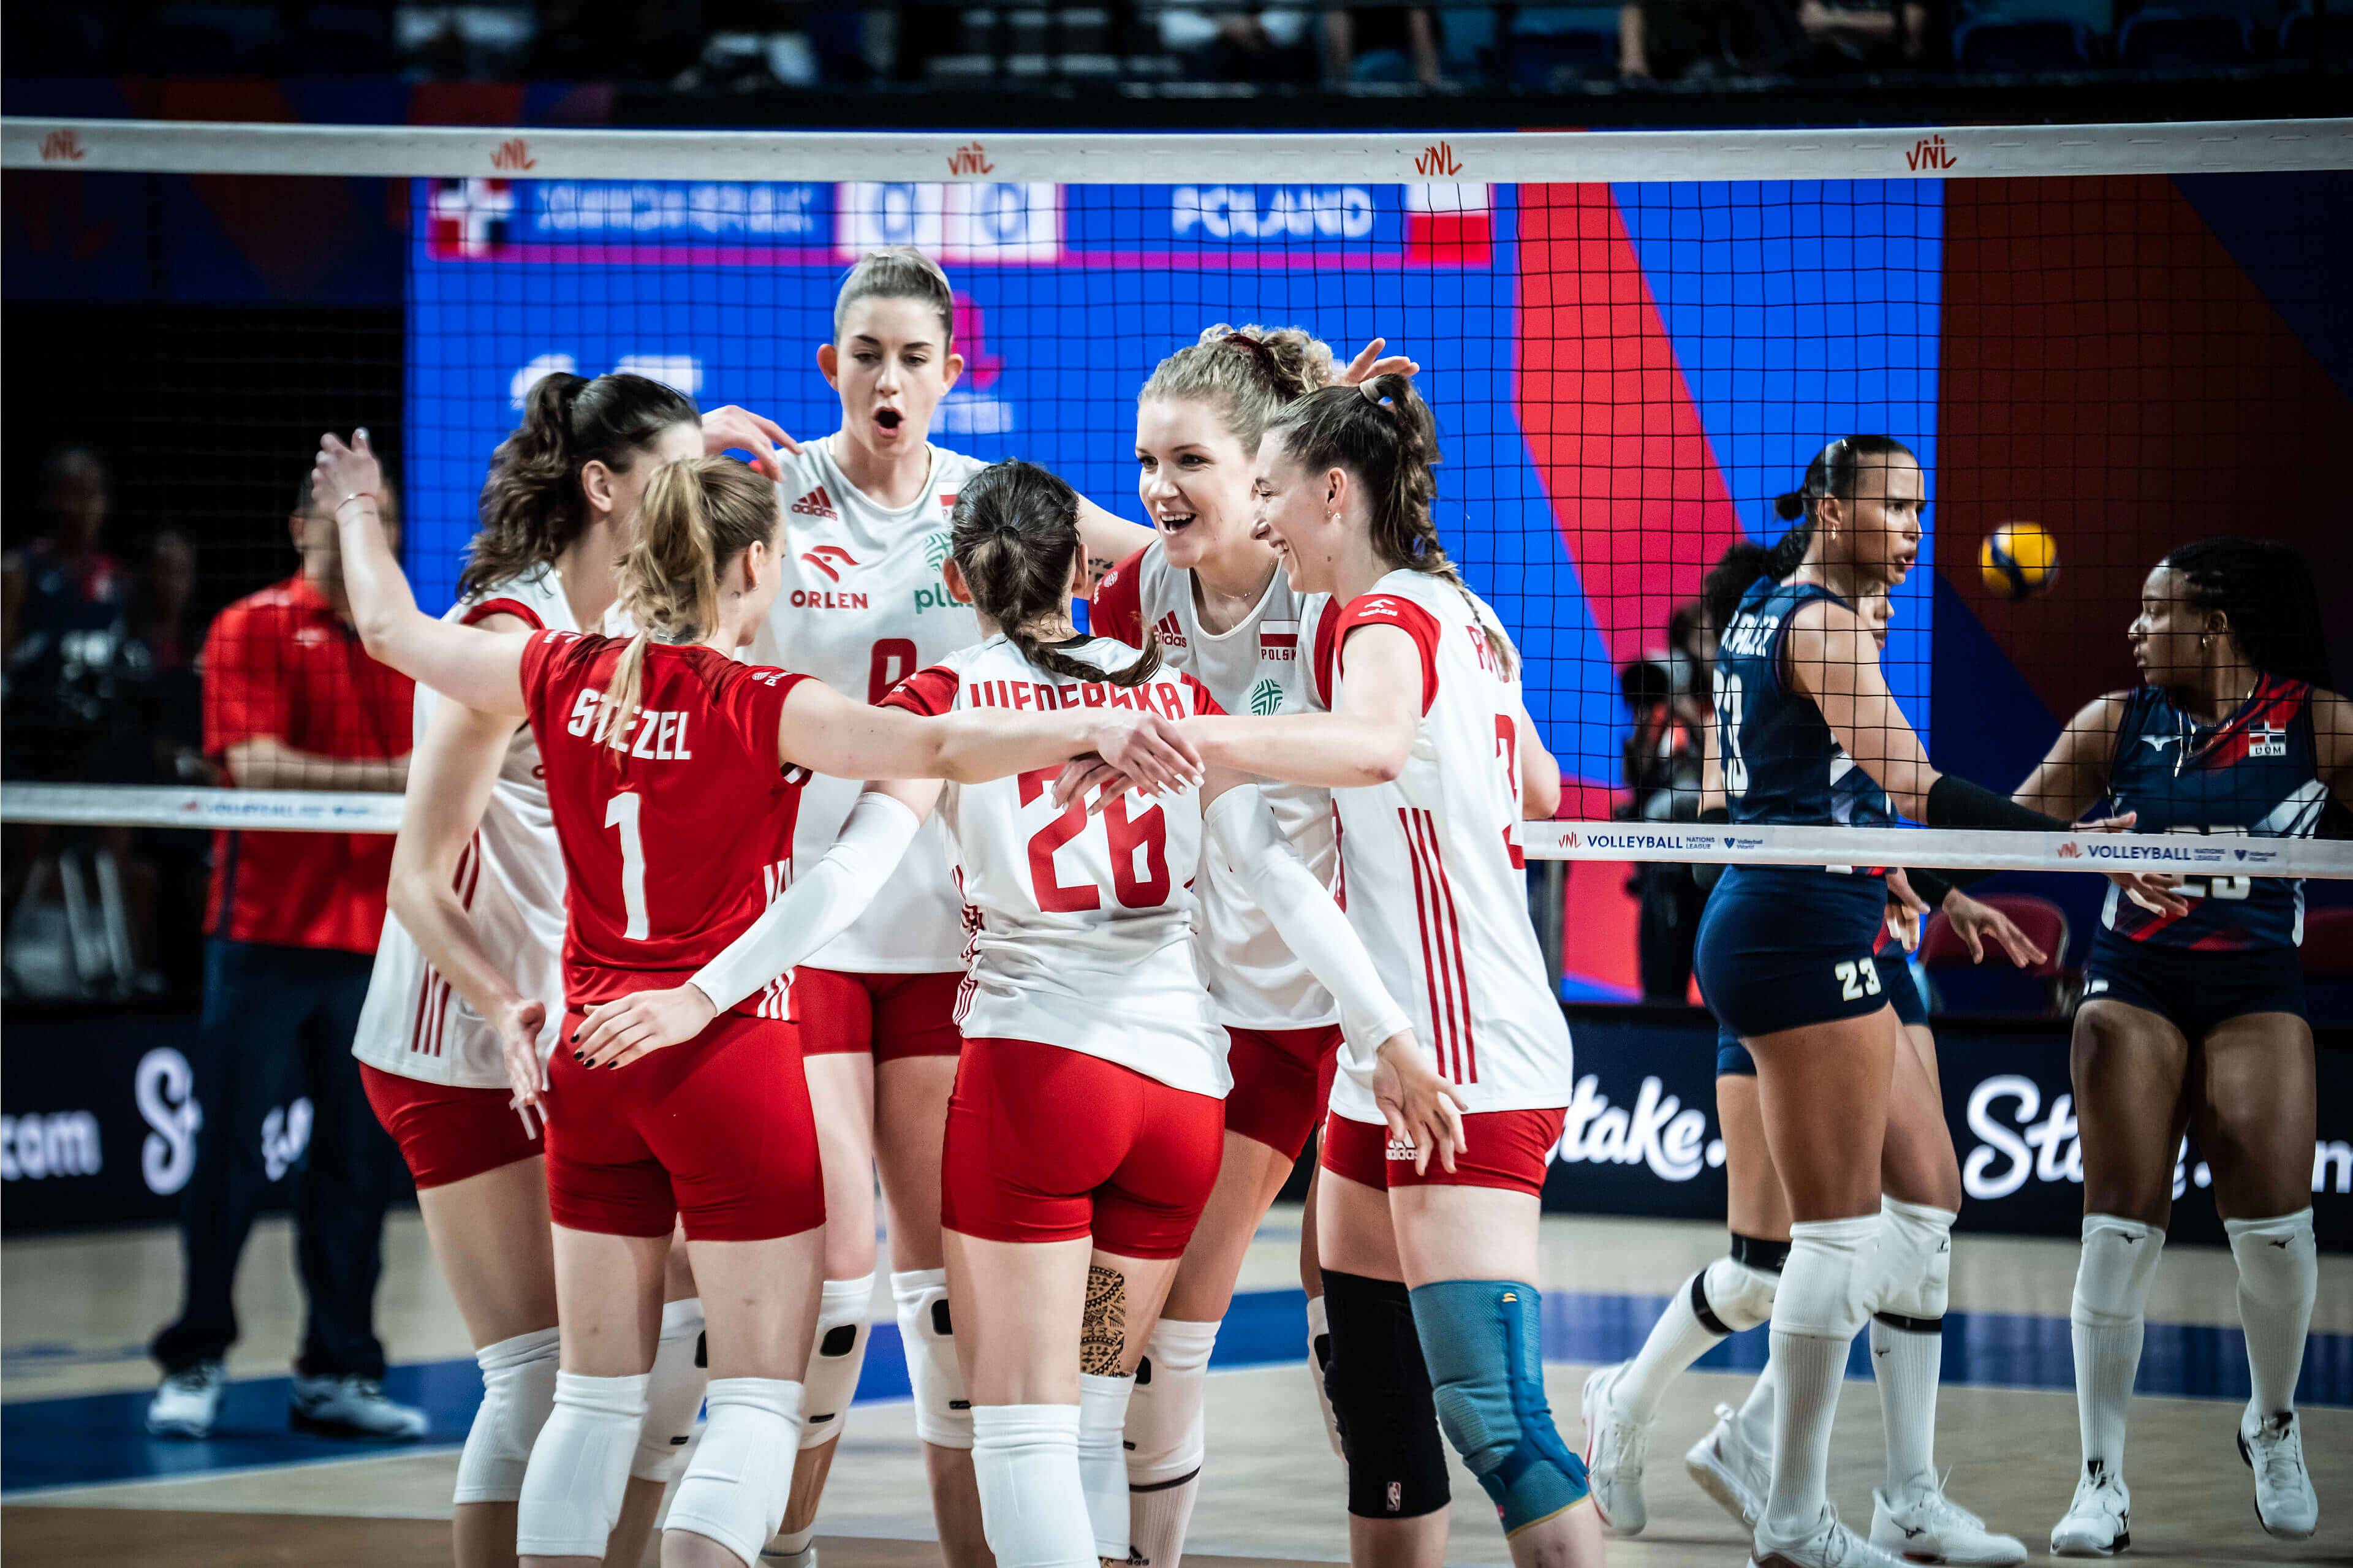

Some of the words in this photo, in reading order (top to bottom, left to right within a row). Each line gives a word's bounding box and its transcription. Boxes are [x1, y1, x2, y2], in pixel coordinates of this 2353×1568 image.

[947, 142, 995, 176] VNL
[1415, 140, 1463, 176] VNL
[1906, 134, 1958, 171] VNL
[791, 503, 838, 522] adidas
[790, 589, 868, 608] ORLEN
[913, 583, 974, 615] plu
[2255, 746, 2281, 755] DOM
[1017, 763, 1171, 914] 26
[1558, 831, 1582, 849] VNL
[1587, 835, 1683, 849] VOLLEYBALL
[2087, 844, 2192, 861] VOLLEYBALL
[604, 792, 649, 941] 1
[1834, 956, 1882, 1001] 23
[1545, 1074, 1726, 1181] take.
